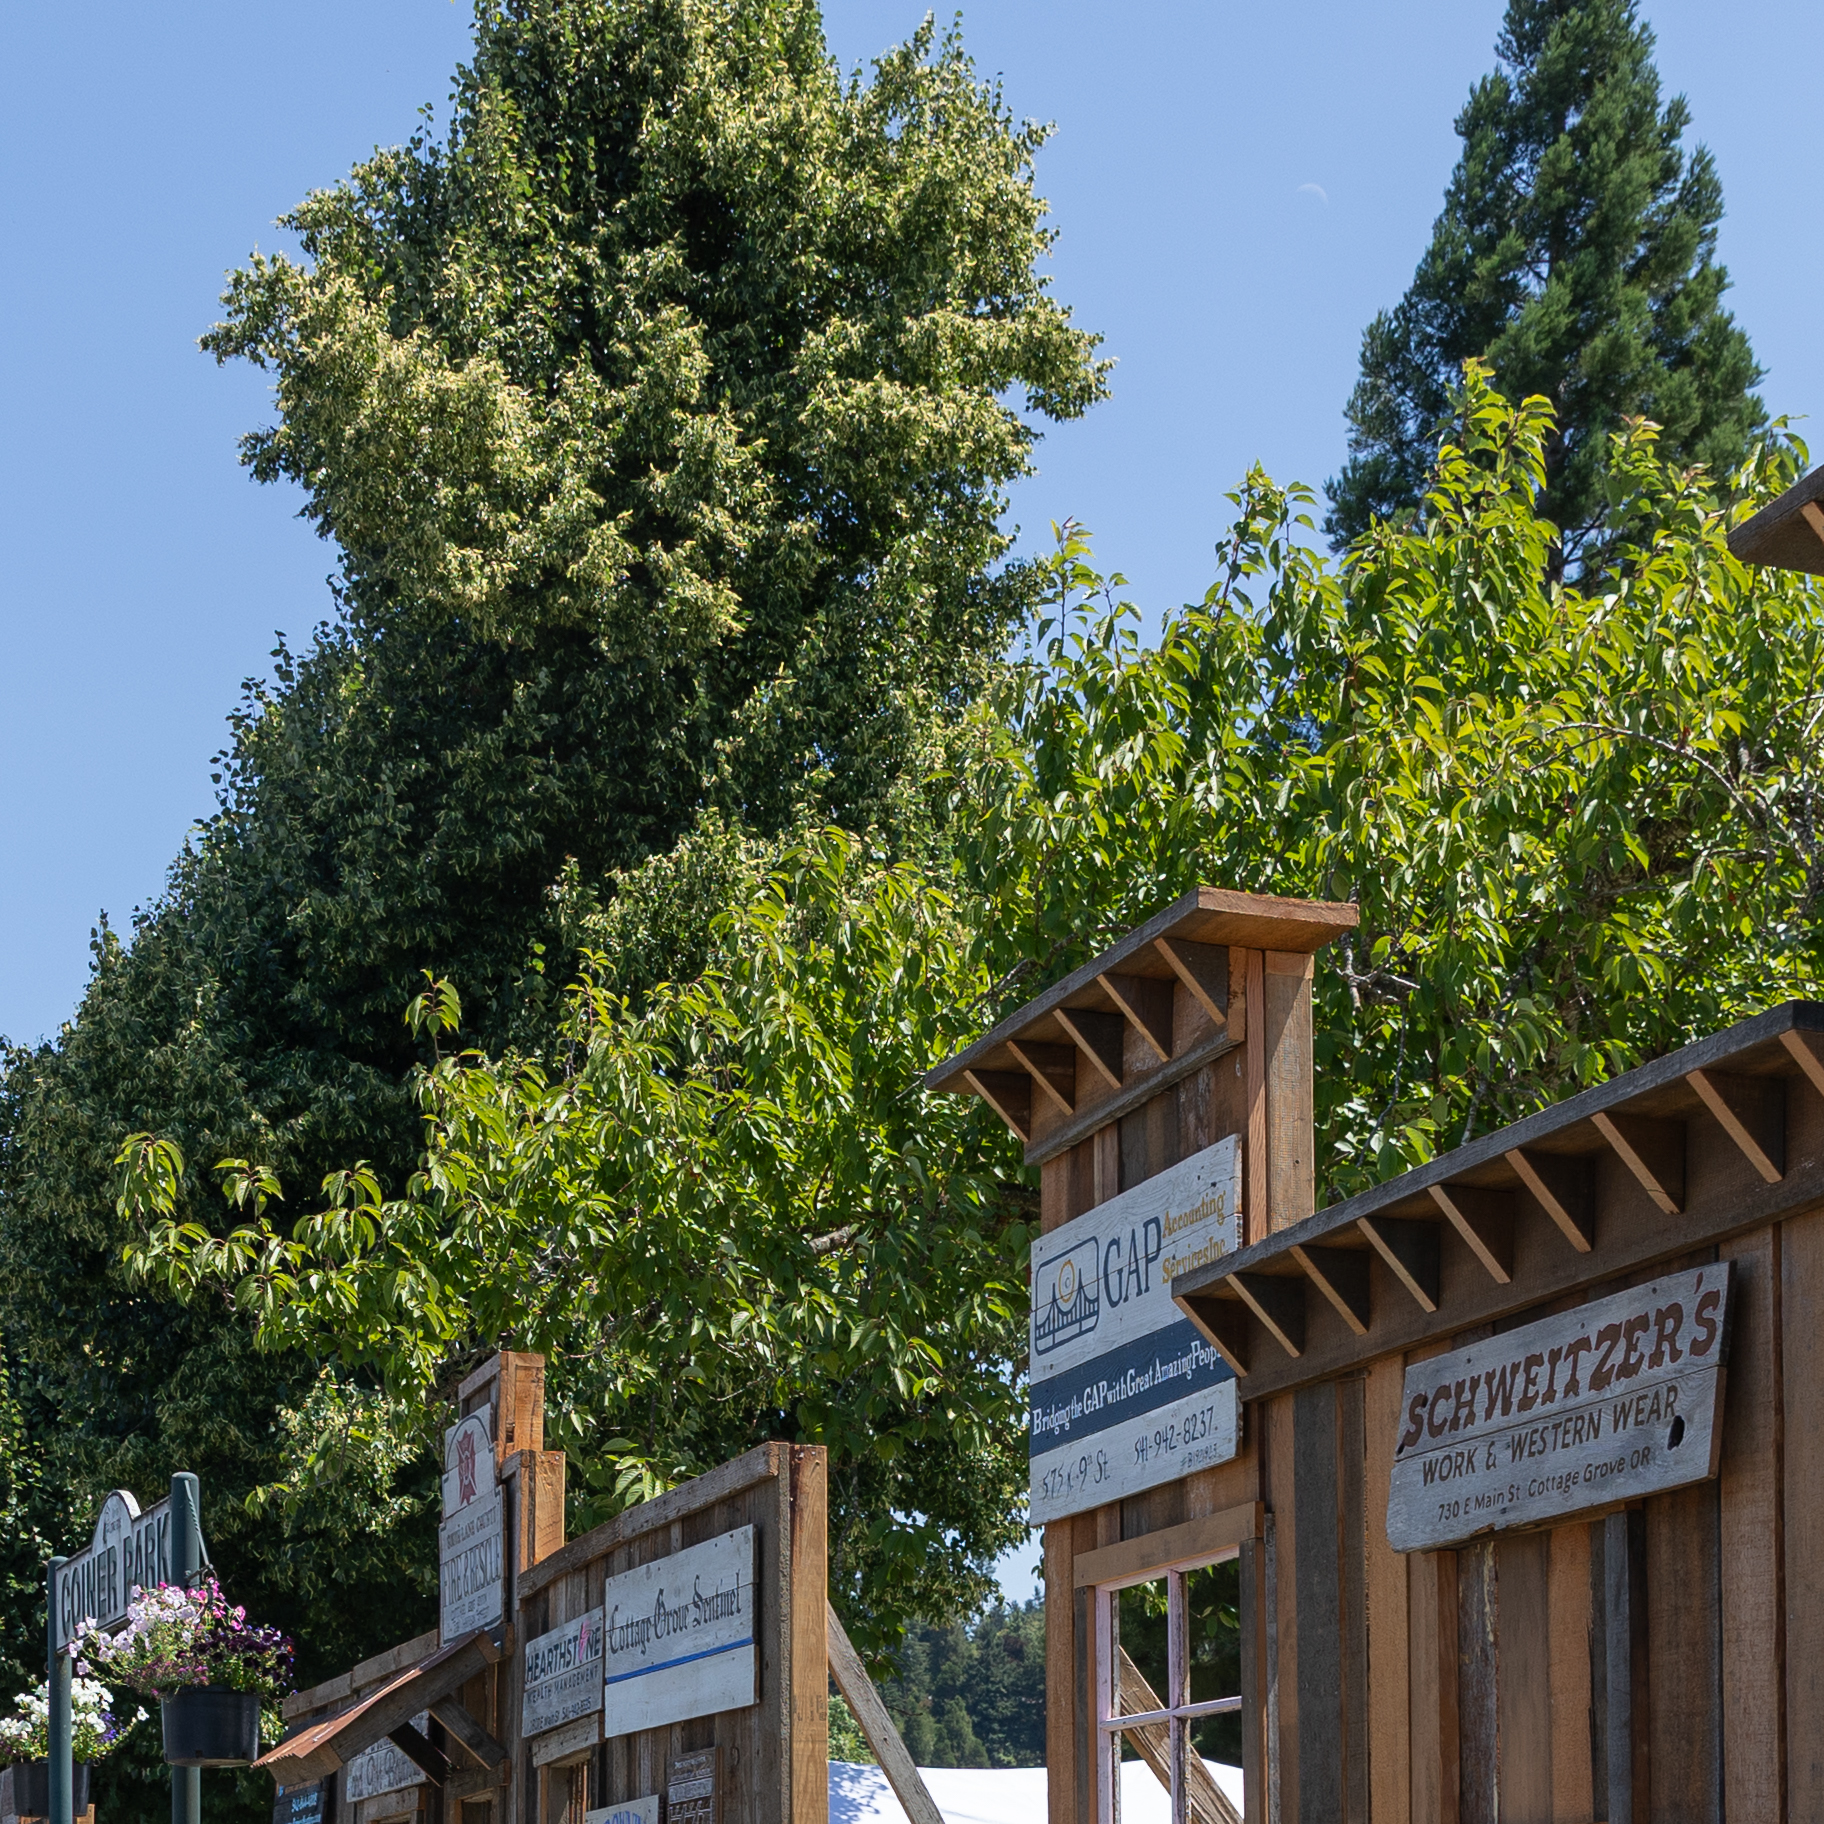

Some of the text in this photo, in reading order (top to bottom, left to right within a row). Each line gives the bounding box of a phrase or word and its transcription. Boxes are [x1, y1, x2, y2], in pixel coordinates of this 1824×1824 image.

[1163, 1189, 1226, 1239] Accounting
[1103, 1216, 1163, 1308] GAP
[1032, 1340, 1221, 1435] Bridging the GAP with Great Amazing Peop
[1402, 1271, 1721, 1448] SCHWEITZER'S
[1421, 1384, 1679, 1487] WORK & WESTERN WEAR
[1437, 1445, 1652, 1522] 730 E Main St Cottage Grove OR
[61, 1511, 170, 1640] COINER PARK
[609, 1569, 742, 1656] Cottage Grove Sentinel
